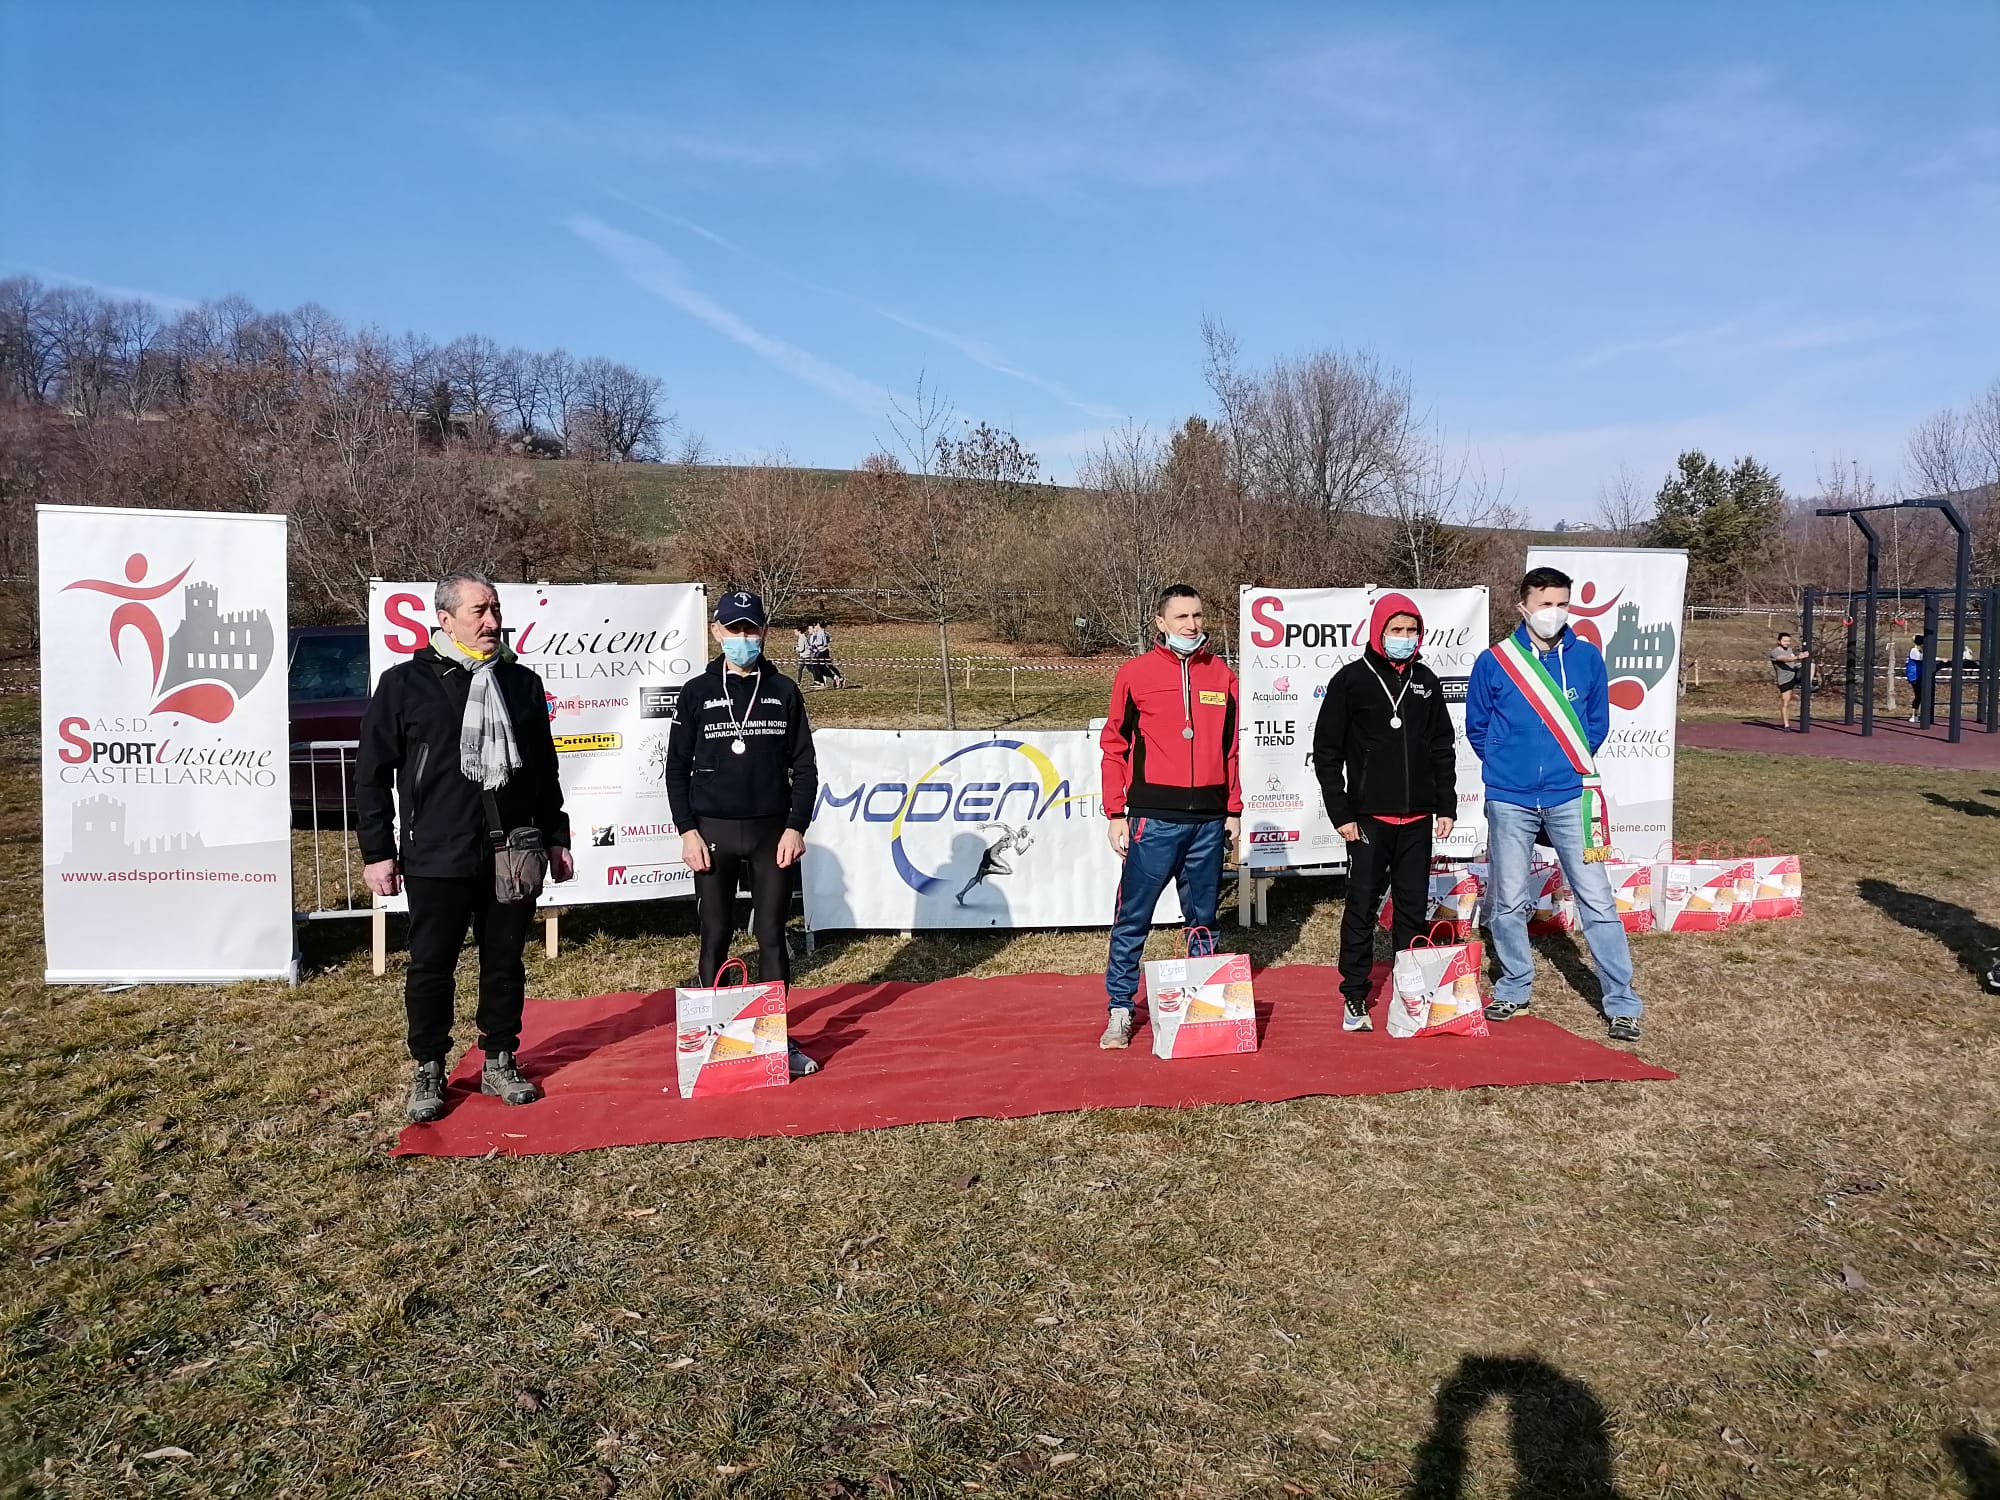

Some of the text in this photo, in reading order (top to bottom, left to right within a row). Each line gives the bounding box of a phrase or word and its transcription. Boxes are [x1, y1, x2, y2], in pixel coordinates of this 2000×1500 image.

[1252, 654, 1306, 669] A.S.D.
[1252, 690, 1298, 702] Acquolina
[557, 698, 629, 709] AIR SPRAYING
[93, 717, 153, 732] A.S.D.
[1255, 721, 1296, 734] TILE
[1255, 736, 1294, 746] TREND
[59, 767, 276, 787] CASTELLARANO
[812, 780, 1070, 822] MODENA
[1248, 800, 1304, 809] TECNOLOGIES
[61, 869, 277, 883] www.asdsportinsieme.com
